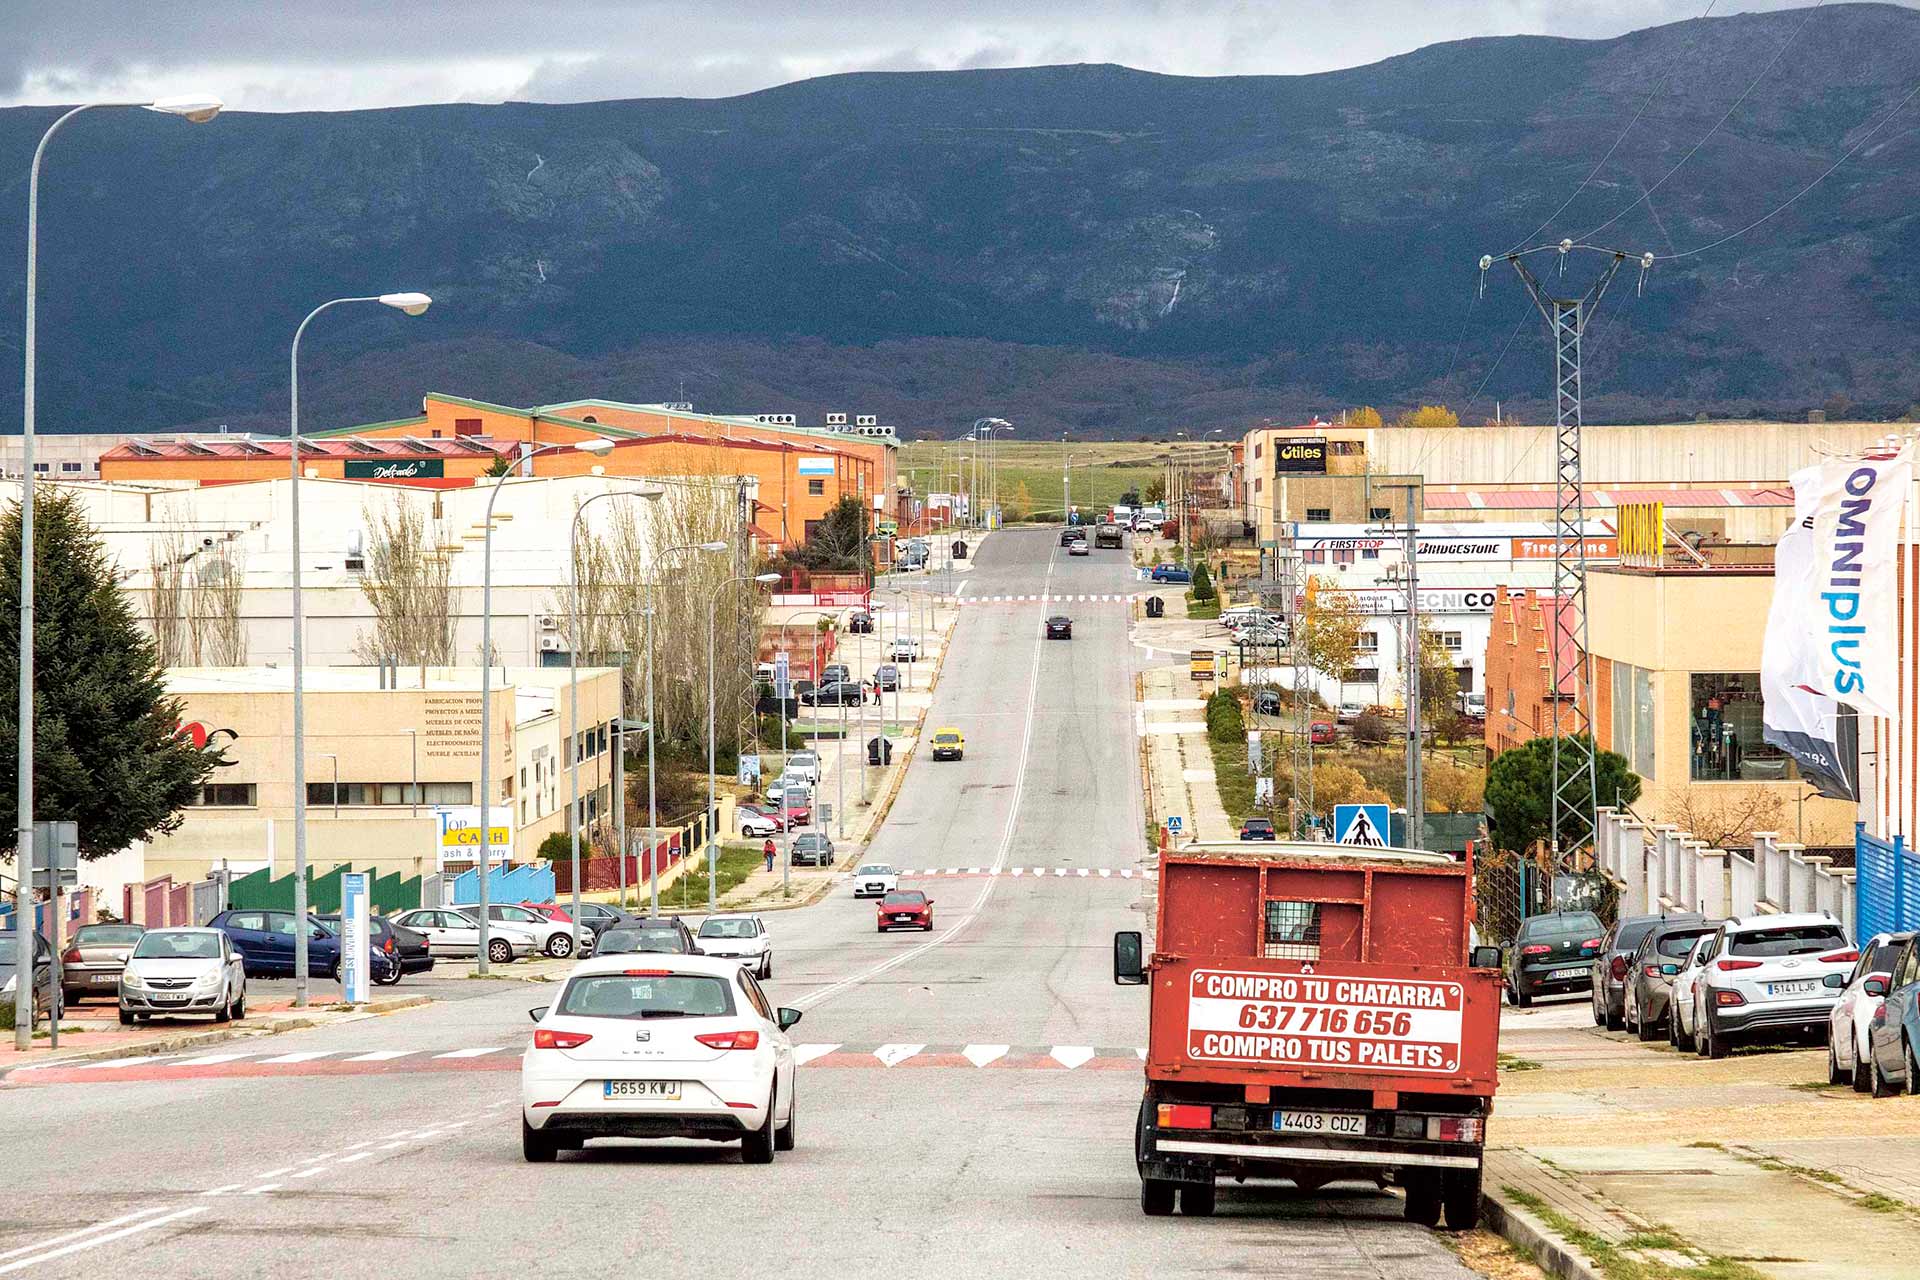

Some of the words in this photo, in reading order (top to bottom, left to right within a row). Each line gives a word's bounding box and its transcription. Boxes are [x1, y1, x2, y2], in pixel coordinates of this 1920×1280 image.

[1417, 543, 1500, 555] BRIDGESTONE
[458, 832, 502, 843] CAH
[1206, 975, 1298, 1001] COMPRO
[1303, 981, 1329, 1002] TU
[1335, 982, 1447, 1008] CHATARRA
[1774, 983, 1796, 994] 5141
[1799, 982, 1816, 992] LJG
[1238, 1004, 1297, 1031] 637
[1299, 1007, 1349, 1034] 716
[1353, 1010, 1413, 1037] 656
[1203, 1034, 1301, 1060] COMPRO
[1308, 1039, 1351, 1063] TUS
[1358, 1042, 1443, 1067] PALETS
[612, 1081, 646, 1095] 5659
[649, 1081, 676, 1095] KWJ
[1283, 1114, 1323, 1130] 4403
[1330, 1116, 1360, 1132] CDZ
